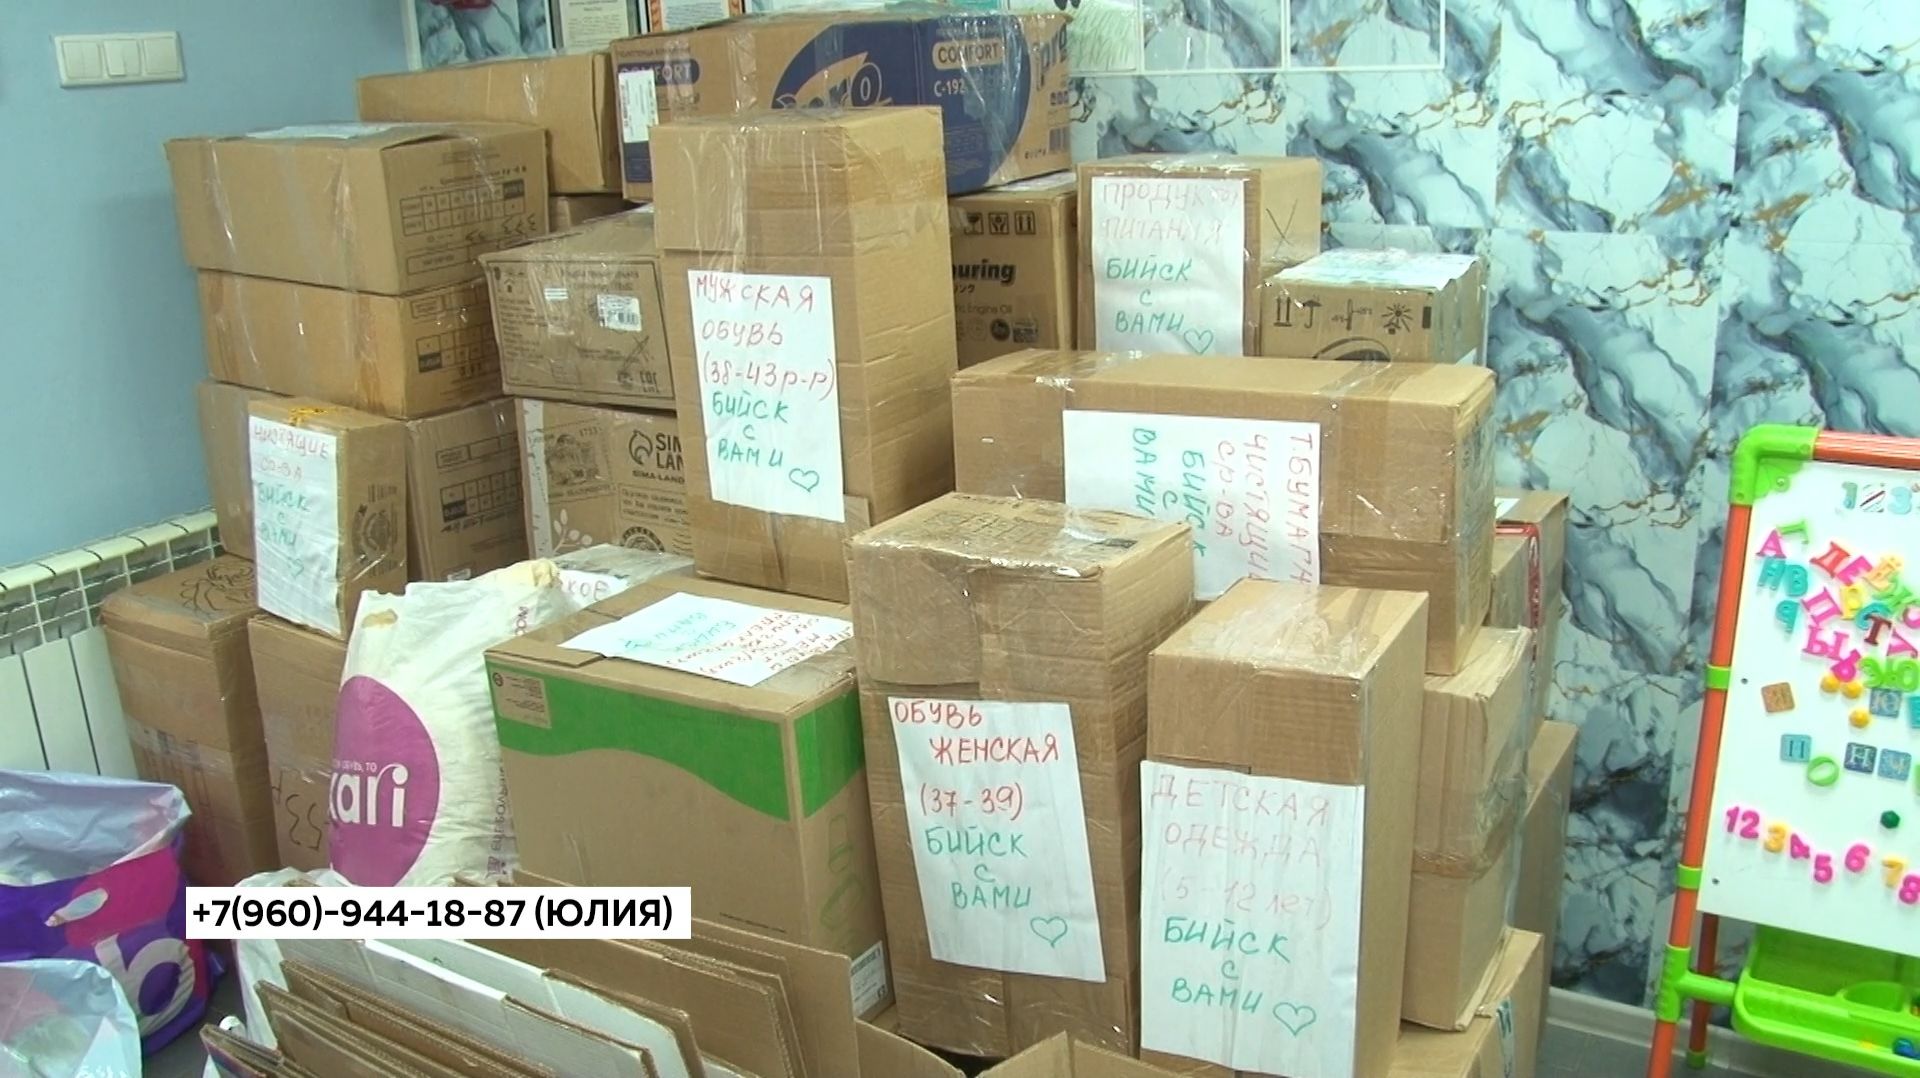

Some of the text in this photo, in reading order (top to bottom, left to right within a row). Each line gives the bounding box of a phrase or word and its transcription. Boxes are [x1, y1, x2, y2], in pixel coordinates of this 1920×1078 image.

[938, 43, 1000, 64] COMFORT
[1106, 253, 1192, 282] БИЙСК
[696, 275, 813, 312] МУЖСКАЯ
[703, 320, 783, 347] ОБУВЬ
[1114, 312, 1185, 334] ВАМИ
[713, 390, 789, 423] БИЙСК
[717, 439, 783, 467] ВАМИ
[1132, 427, 1158, 516] ВАМИ
[1239, 434, 1270, 579] ЧИСТЯЩИ
[894, 700, 983, 728] ОБУВЬ
[929, 733, 1060, 766] ЖЕНСКАЯ
[1151, 774, 1331, 827] ДЕТСКАЯ
[925, 825, 1027, 858] БИЙСК
[1165, 822, 1322, 867] ОДЕЖДА
[951, 882, 1031, 909] ВАМИ
[1163, 916, 1291, 964] БИЙСК
[1171, 977, 1263, 1014] ВАМИ
